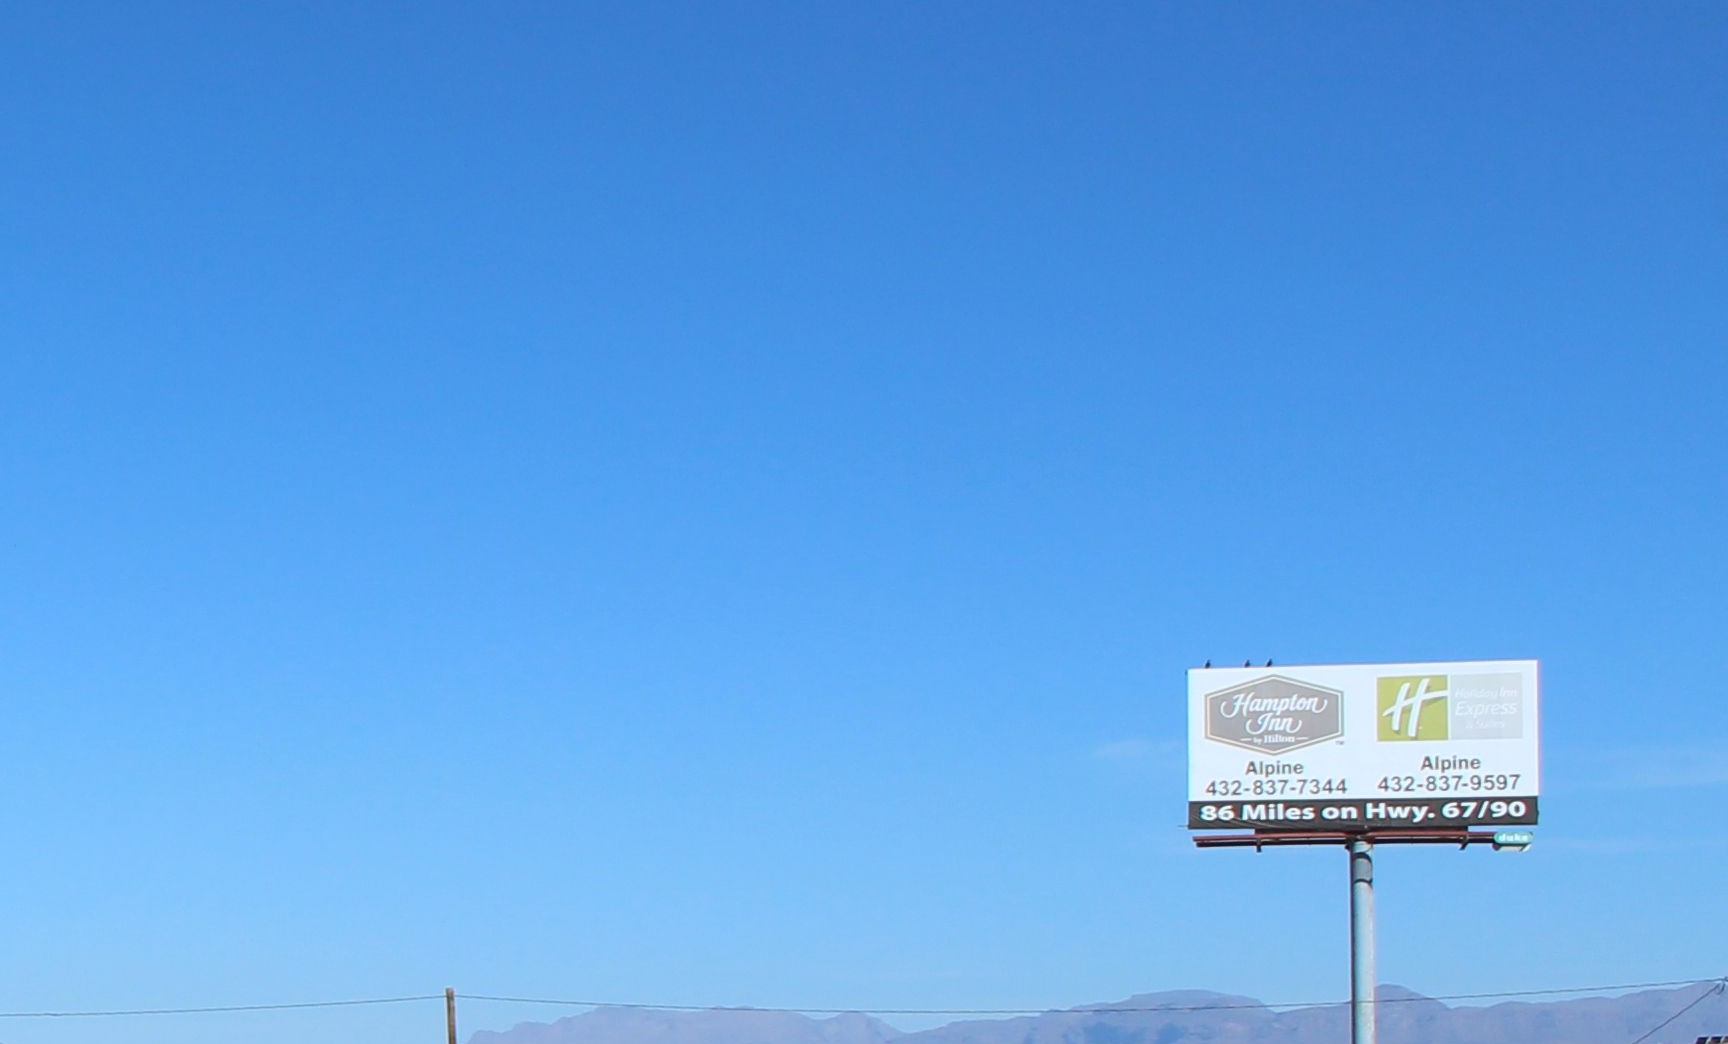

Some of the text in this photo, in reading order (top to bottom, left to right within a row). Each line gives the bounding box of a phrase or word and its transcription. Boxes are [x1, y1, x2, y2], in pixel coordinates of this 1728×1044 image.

[1220, 692, 1328, 718] Hampton
[1455, 700, 1518, 718] Express
[1246, 713, 1302, 735] Inn
[1264, 733, 1295, 744] Hilton
[1245, 760, 1304, 777] Alpine
[1420, 755, 1481, 773] Alpine
[1205, 778, 1348, 796] 432-837-7344
[1377, 774, 1521, 792] 432-837-9597
[1200, 800, 1527, 823] 86 Miles on Hwy. 67/90
